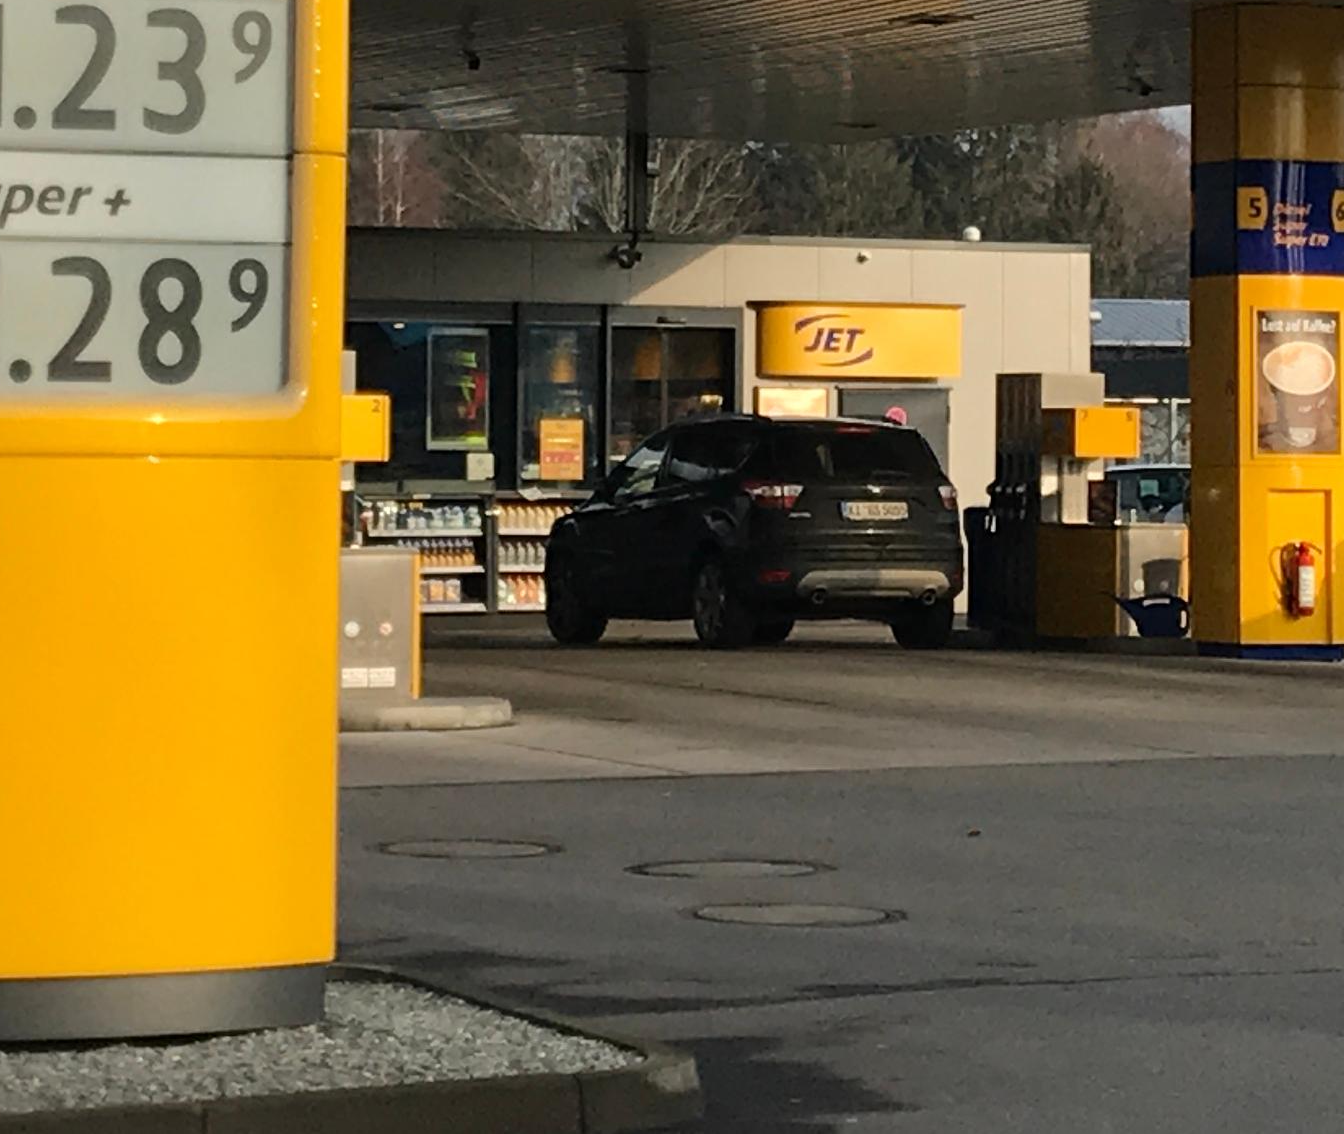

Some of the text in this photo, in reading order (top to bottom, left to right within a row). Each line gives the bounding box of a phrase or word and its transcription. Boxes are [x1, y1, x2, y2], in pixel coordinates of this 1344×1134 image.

[1247, 196, 1263, 219] 5
[1261, 317, 1284, 332] Lust
[1285, 318, 1301, 332] auf
[803, 327, 866, 353] JET
[371, 398, 382, 413] 2
